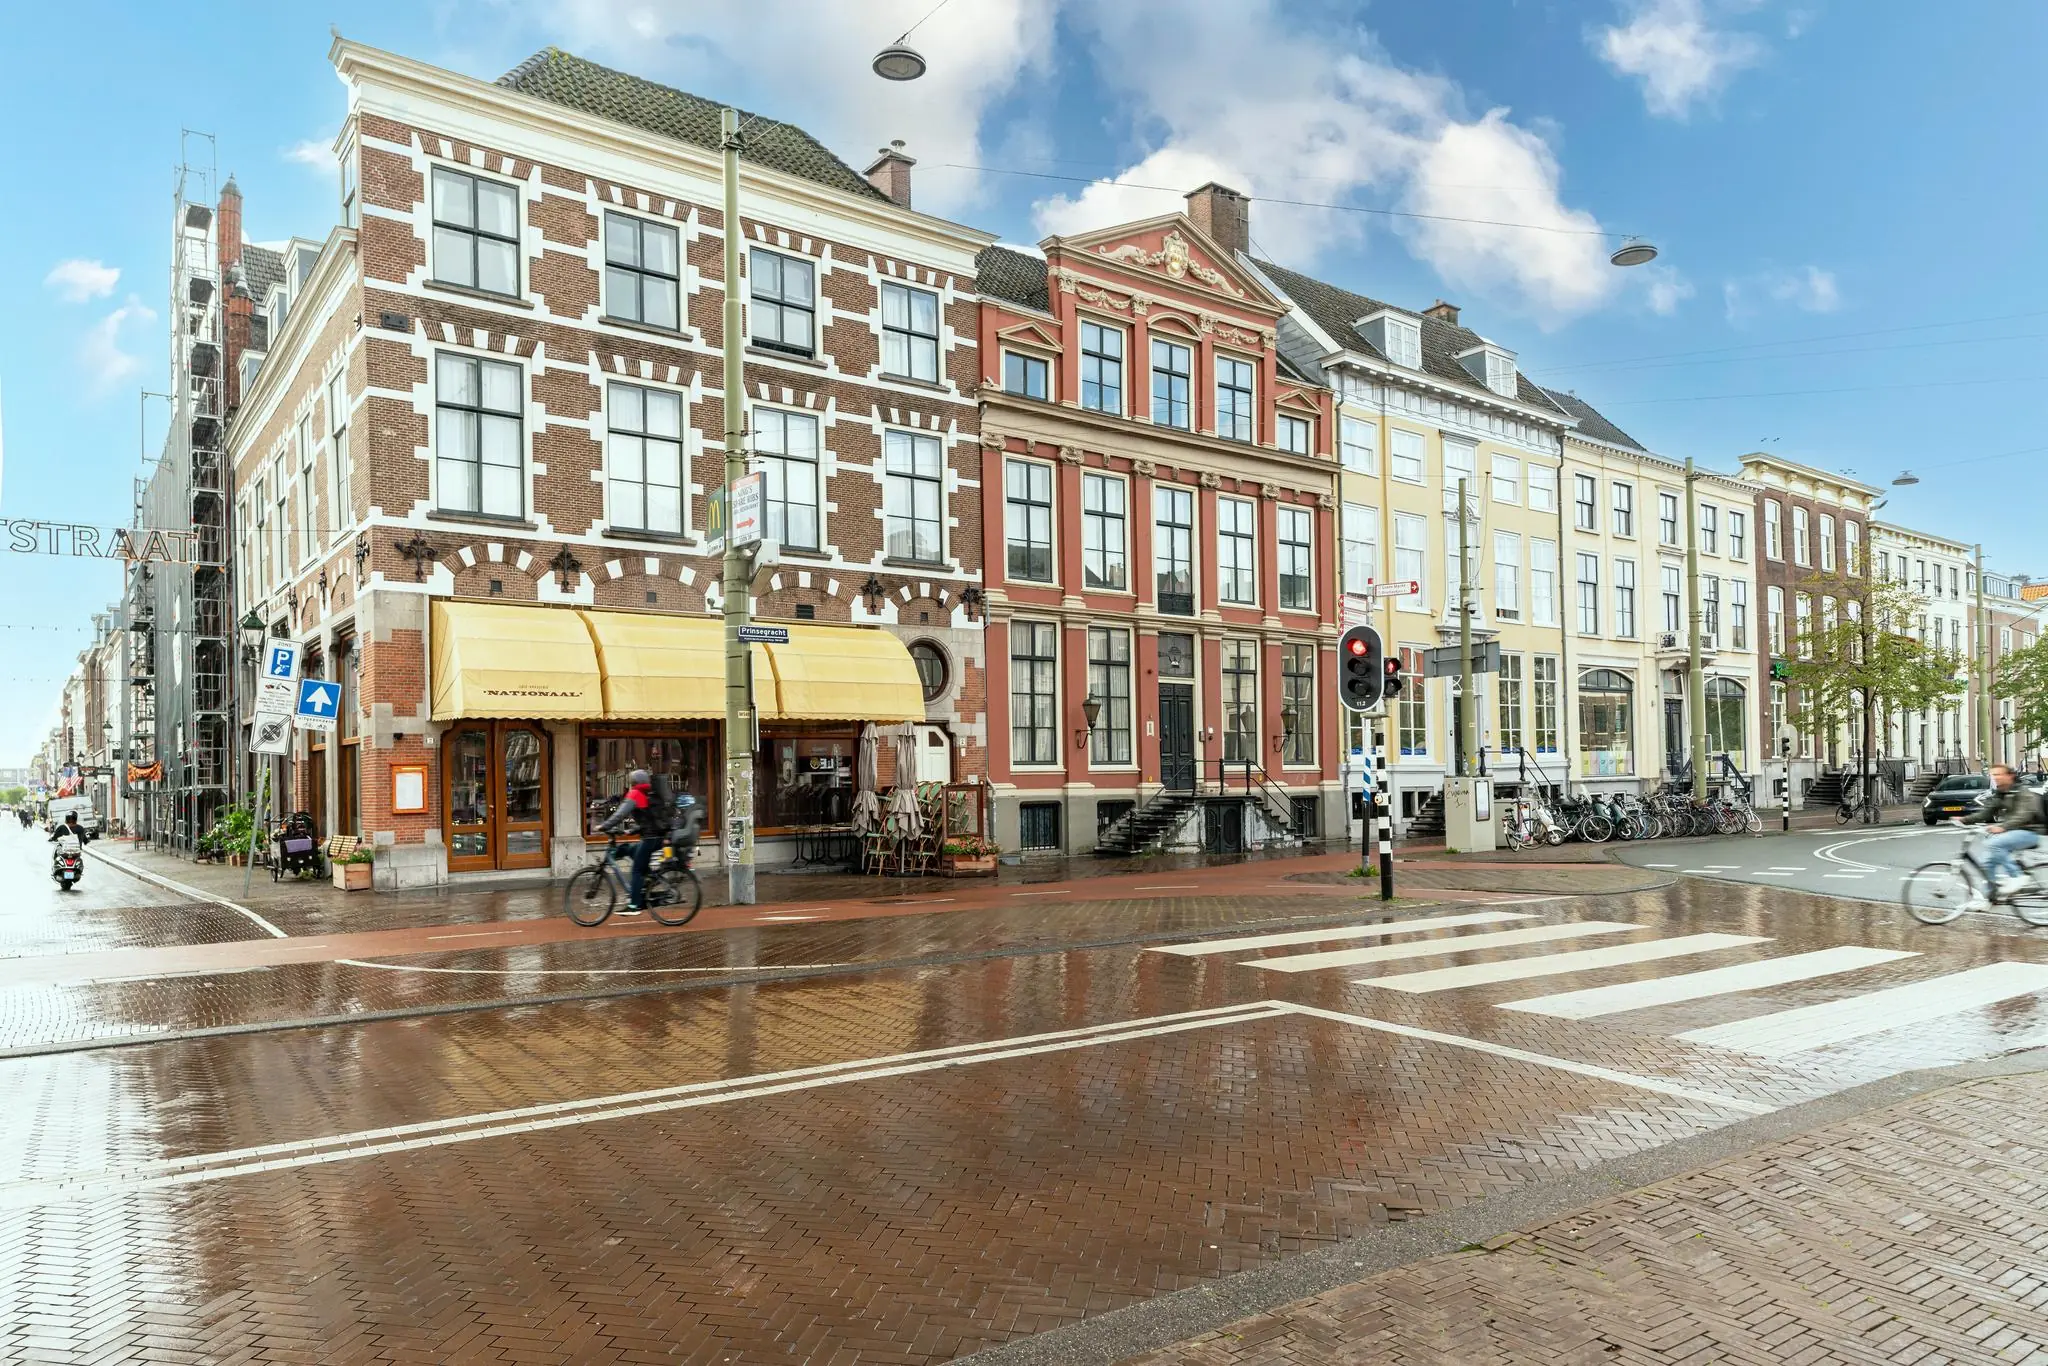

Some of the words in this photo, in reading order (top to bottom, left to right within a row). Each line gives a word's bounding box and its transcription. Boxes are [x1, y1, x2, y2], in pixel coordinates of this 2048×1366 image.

[0, 519, 197, 562] STRAAT
[741, 627, 786, 636] Prinsegracht
[277, 650, 289, 665] P
